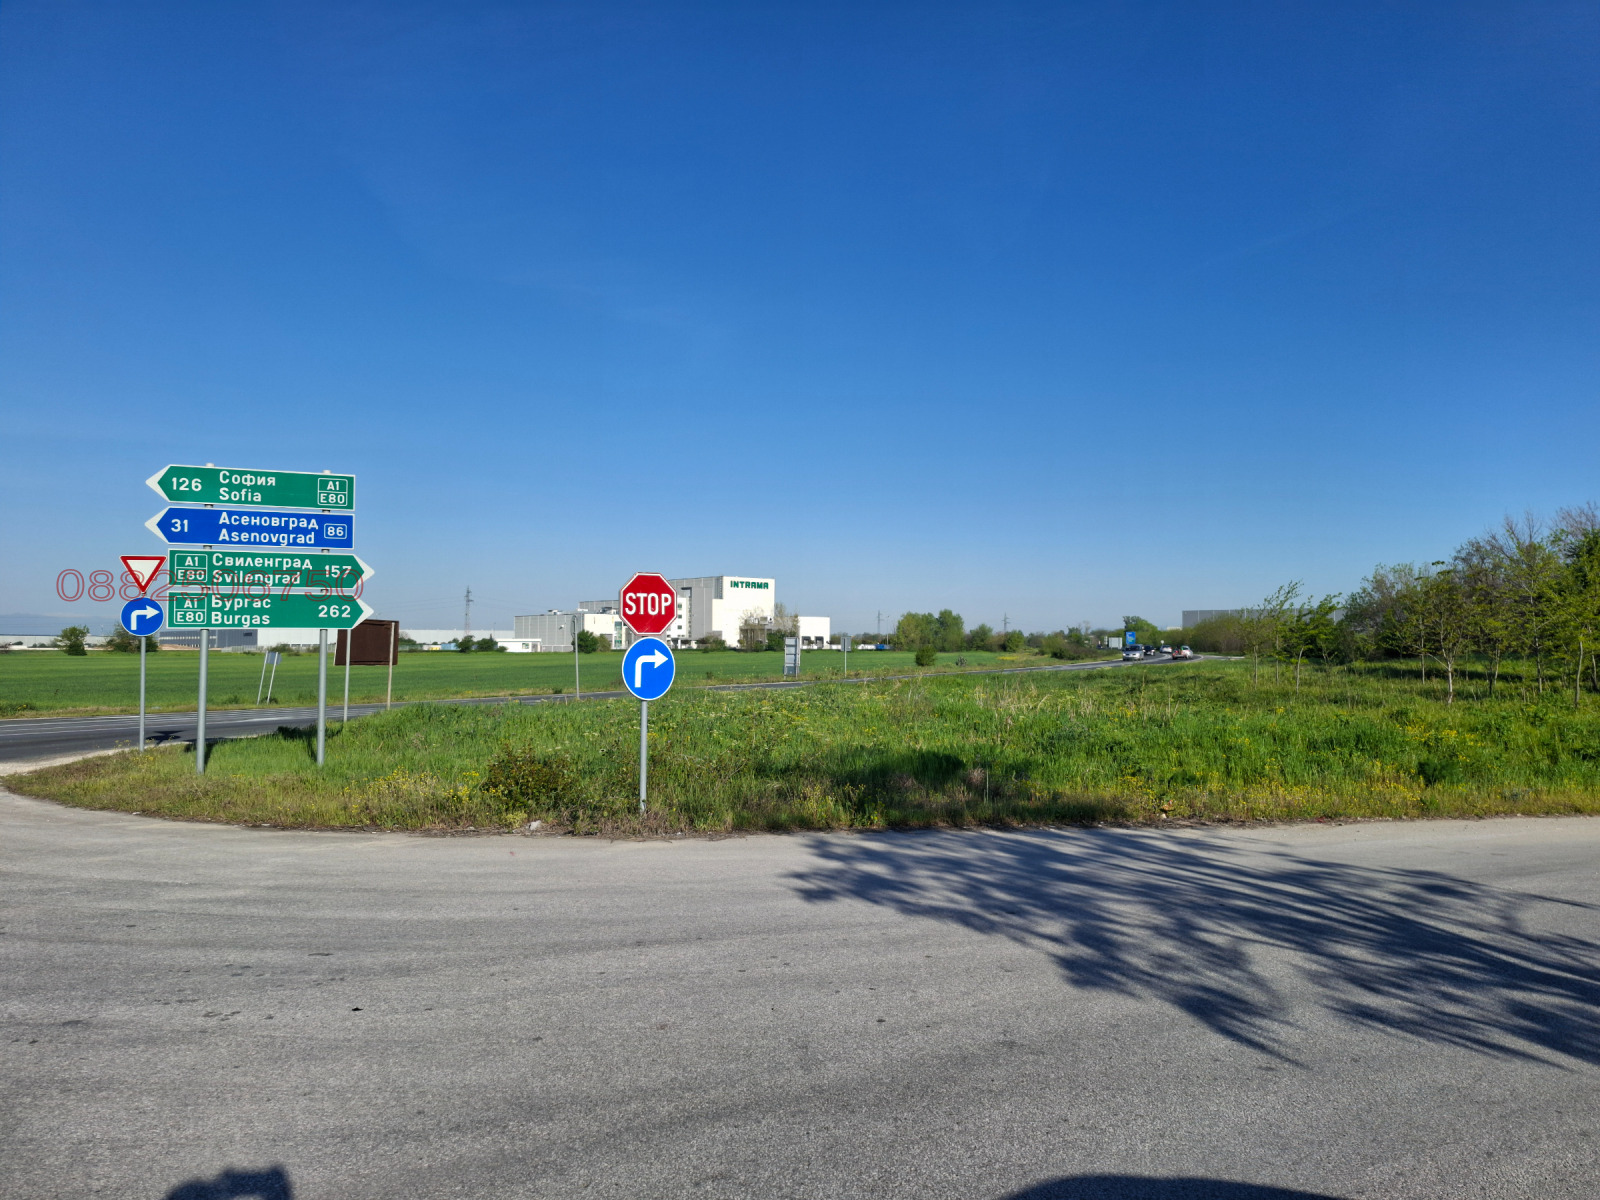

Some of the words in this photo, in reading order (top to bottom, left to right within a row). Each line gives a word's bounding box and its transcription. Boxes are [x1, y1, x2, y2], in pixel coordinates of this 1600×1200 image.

[171, 477, 203, 492] 126
[219, 471, 276, 487] София
[326, 480, 340, 491] A1
[219, 488, 262, 502] Sofia
[320, 493, 346, 504] E80
[171, 519, 188, 533] 31
[219, 512, 318, 530] Асеновград
[219, 528, 315, 546] Asenovgrad
[327, 527, 344, 537] 86
[184, 556, 199, 566] A1
[212, 553, 313, 570] Свиленград
[177, 569, 204, 580] E80
[212, 569, 301, 587] Svilengrad
[324, 564, 352, 578] 157
[730, 580, 769, 590] INTRAMA
[184, 598, 198, 608] A1
[211, 595, 272, 612] Бургас
[625, 592, 672, 615] STOP
[176, 611, 204, 623] E80
[318, 605, 351, 618] 262
[211, 612, 270, 627] Burgas
